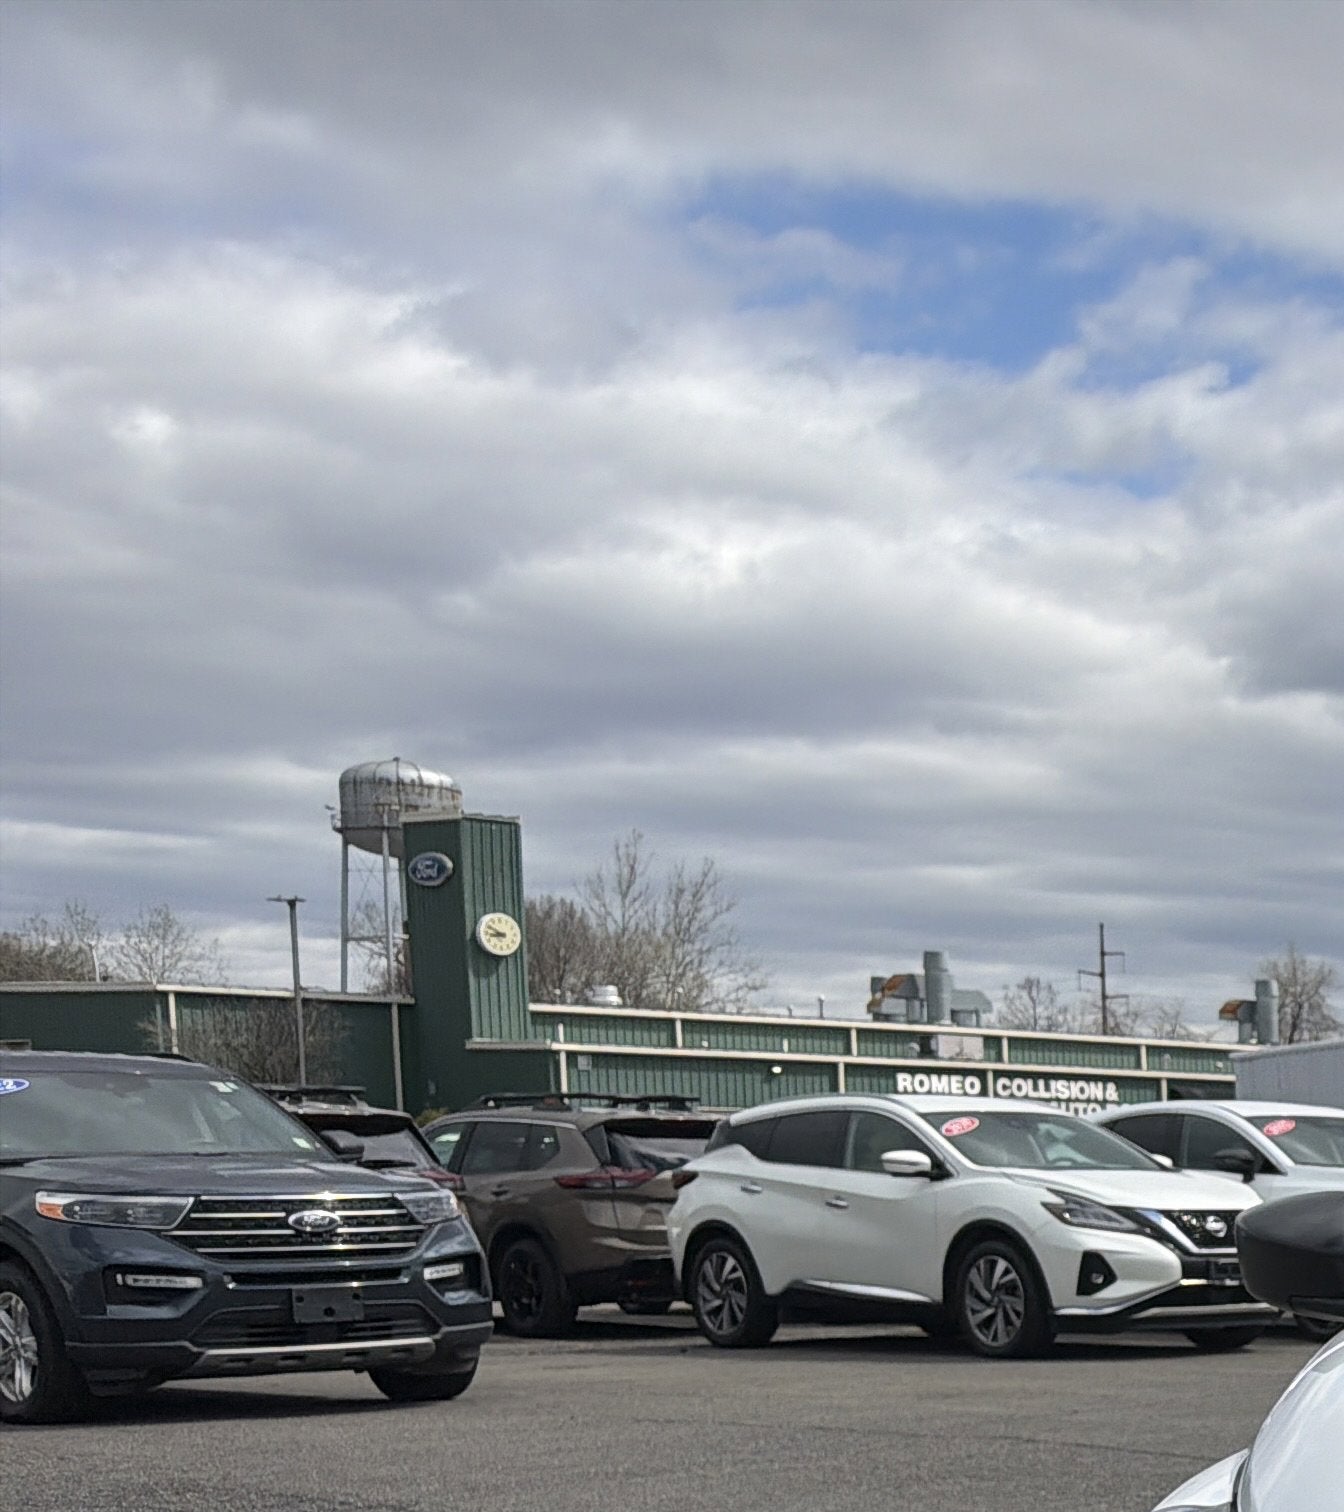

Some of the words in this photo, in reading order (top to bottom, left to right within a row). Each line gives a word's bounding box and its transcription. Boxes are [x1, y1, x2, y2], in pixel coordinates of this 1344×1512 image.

[896, 1072, 981, 1095] ROMEO
[996, 1077, 1103, 1102] COLLISION
[1105, 1082, 1120, 1102] &
